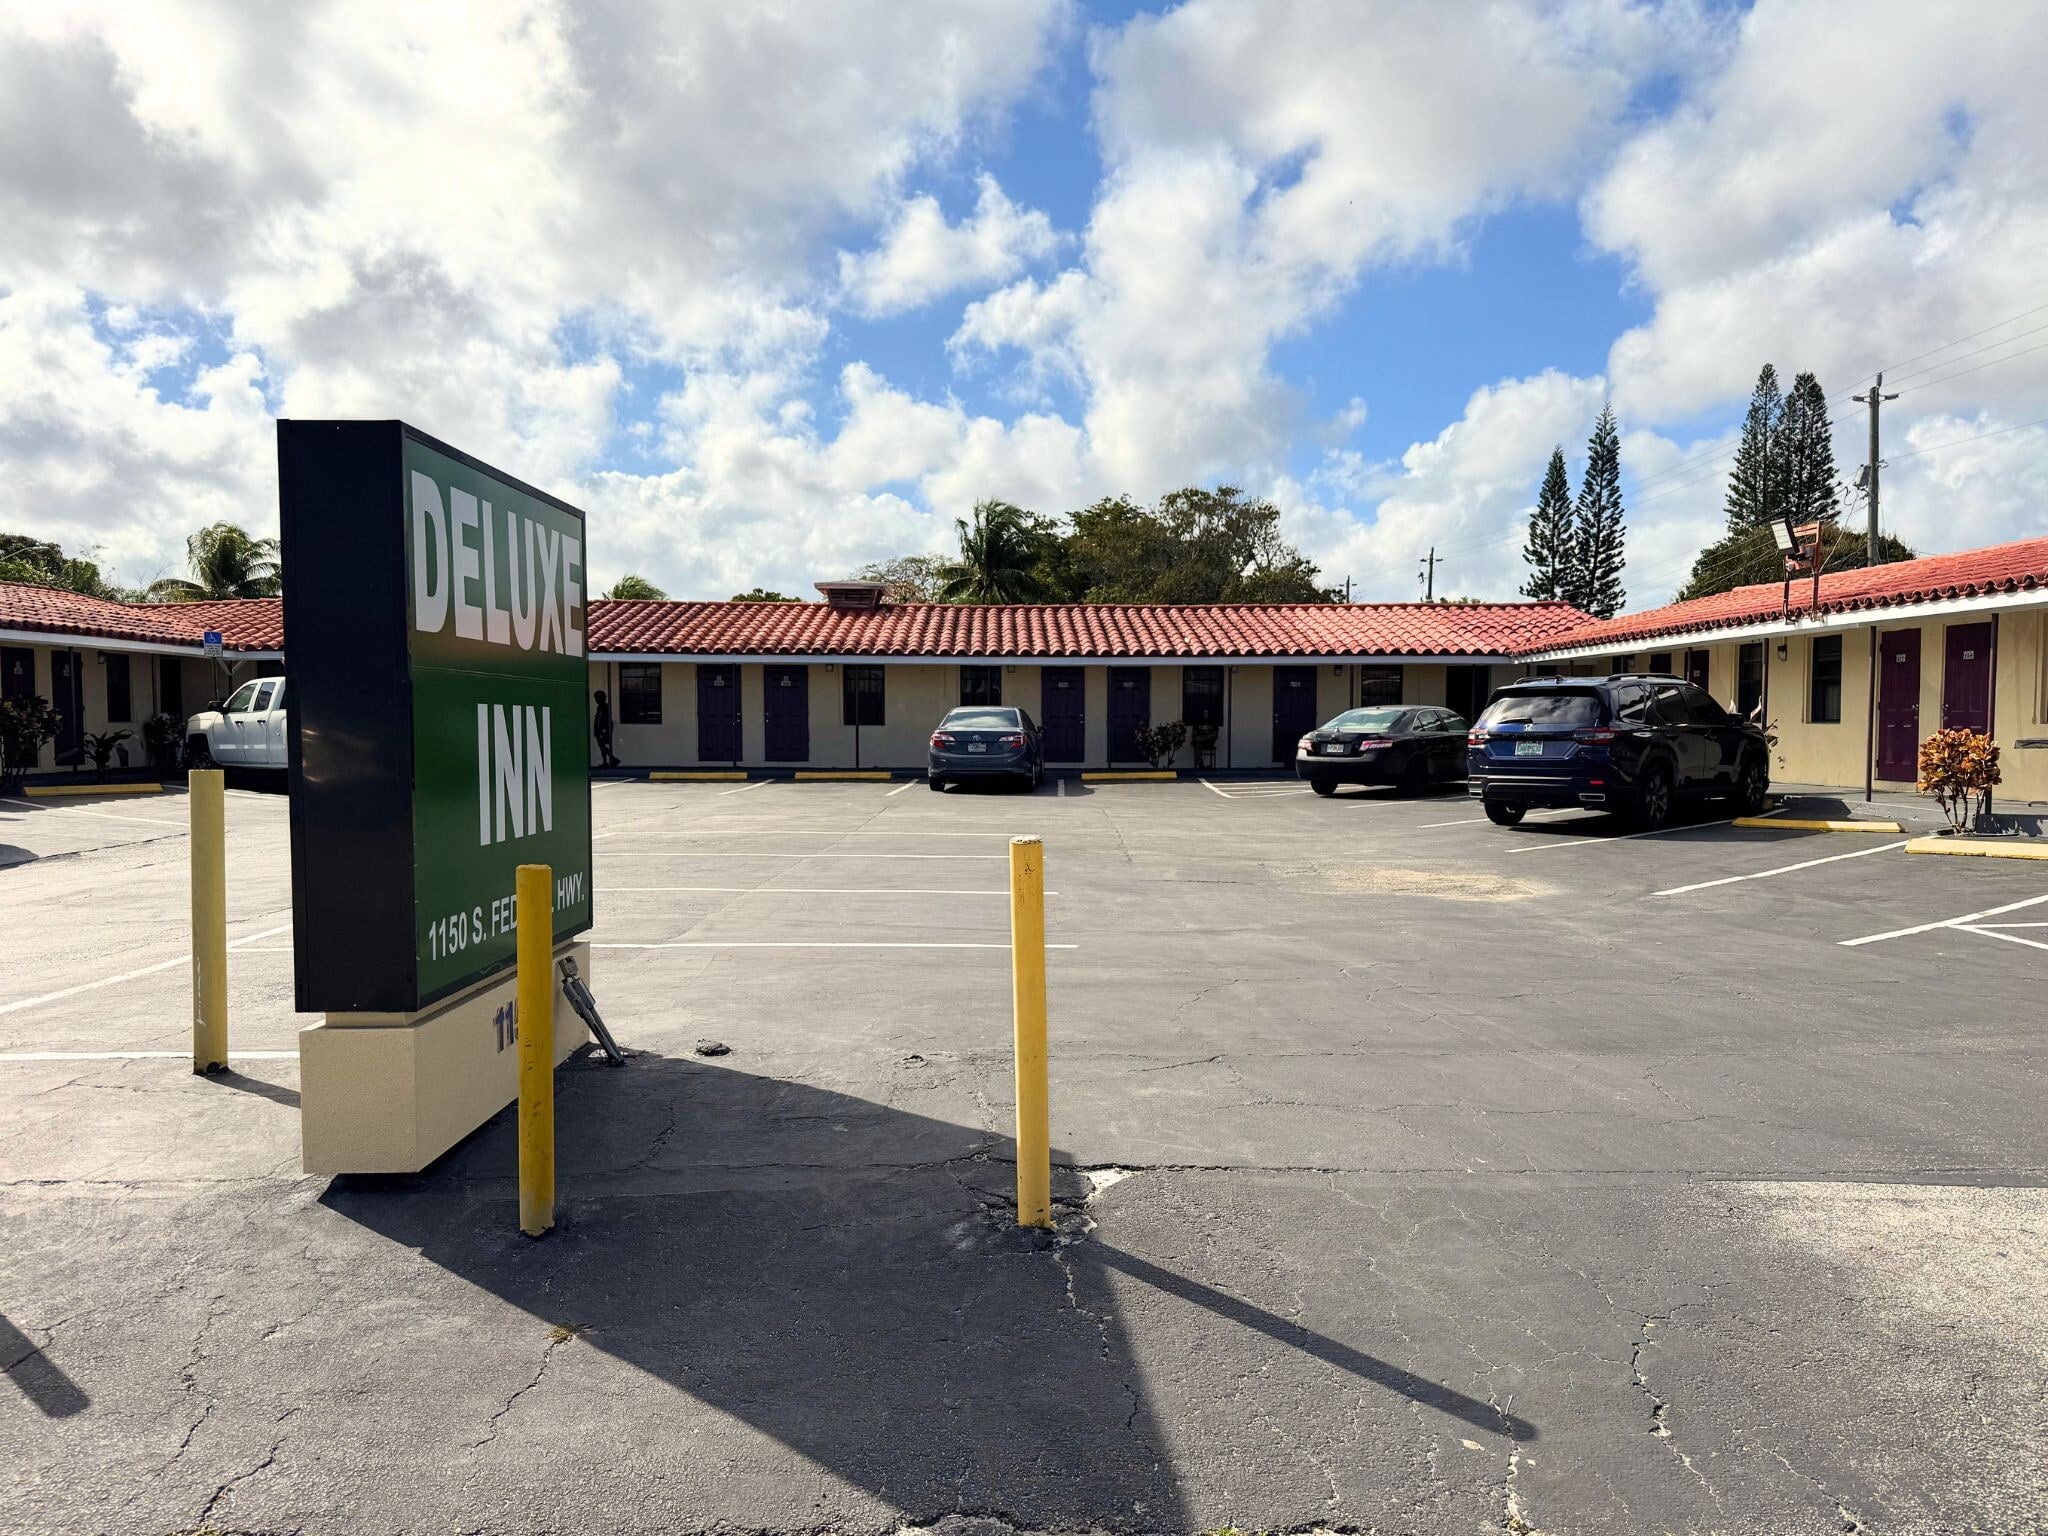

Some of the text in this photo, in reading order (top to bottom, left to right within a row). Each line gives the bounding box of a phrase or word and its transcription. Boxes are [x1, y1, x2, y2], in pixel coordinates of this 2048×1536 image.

[411, 470, 583, 657] DELUXE
[477, 703, 552, 846] INN
[428, 911, 468, 961] 1150
[472, 906, 487, 945] S.
[557, 872, 585, 911] HWY.
[493, 997, 519, 1053] 11
